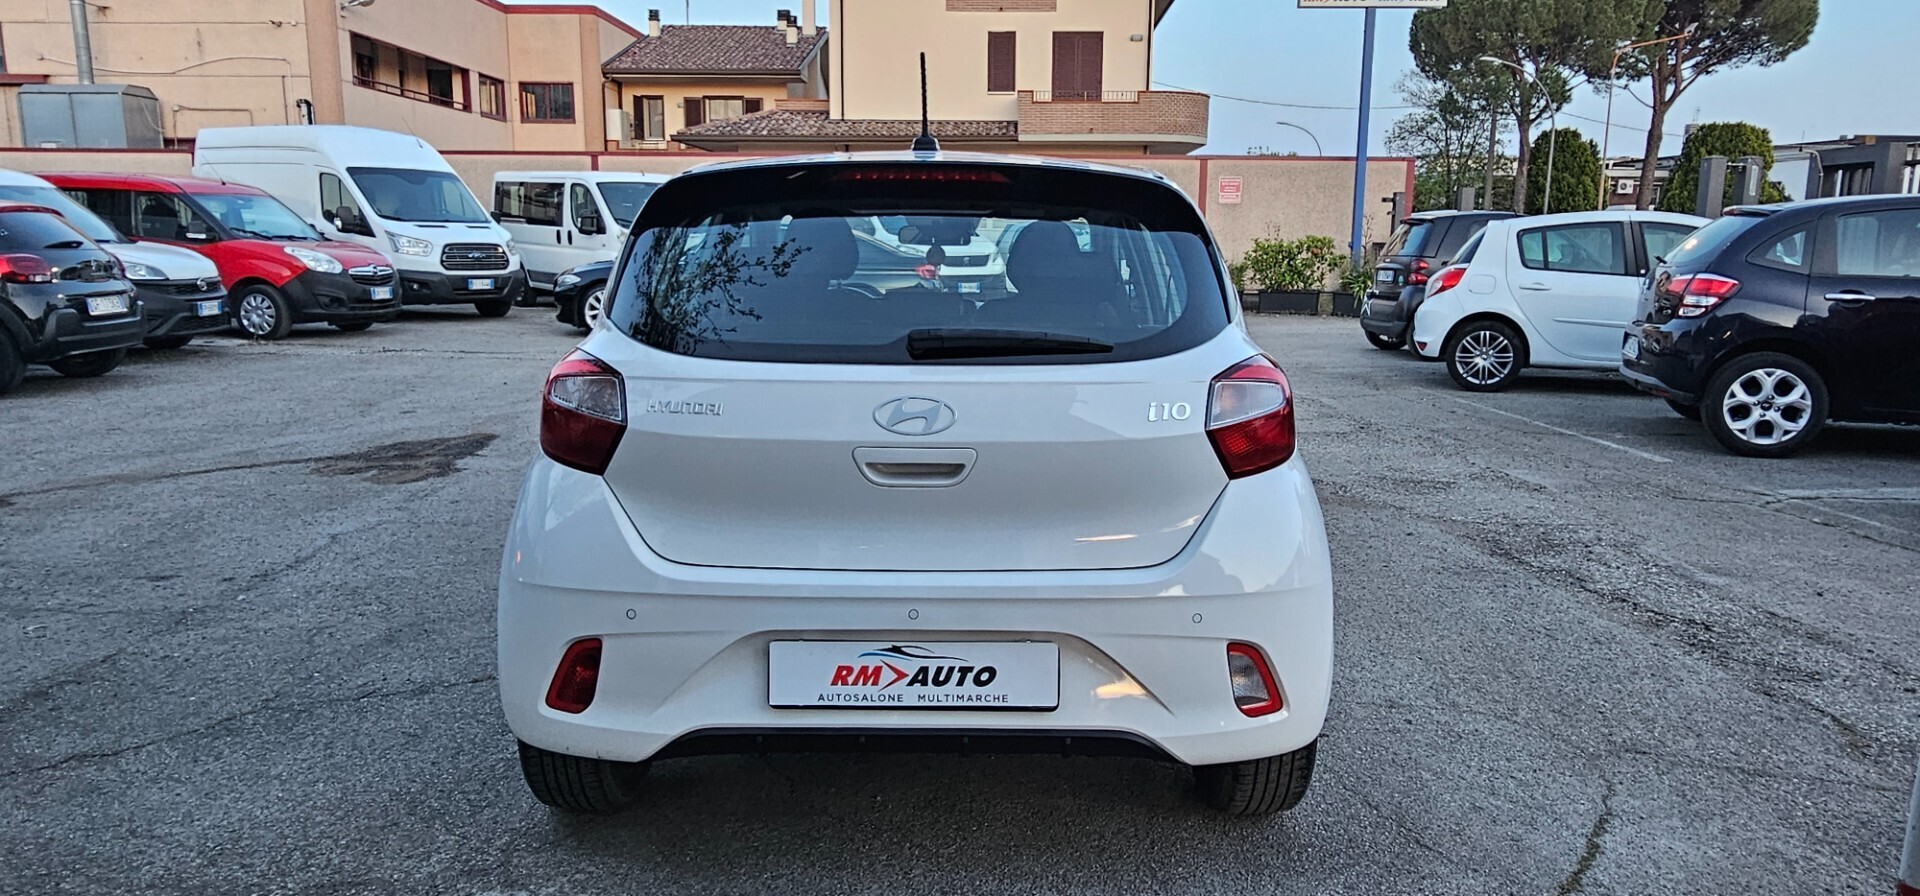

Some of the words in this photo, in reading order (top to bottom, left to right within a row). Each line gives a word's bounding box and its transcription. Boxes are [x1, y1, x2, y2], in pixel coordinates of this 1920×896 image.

[647, 400, 723, 416] HYUNDAI
[1148, 402, 1192, 422] i10
[906, 666, 998, 687] AUTO
[817, 693, 904, 703] AUTOSALONE
[917, 693, 1009, 703] MULTIMARCHE
